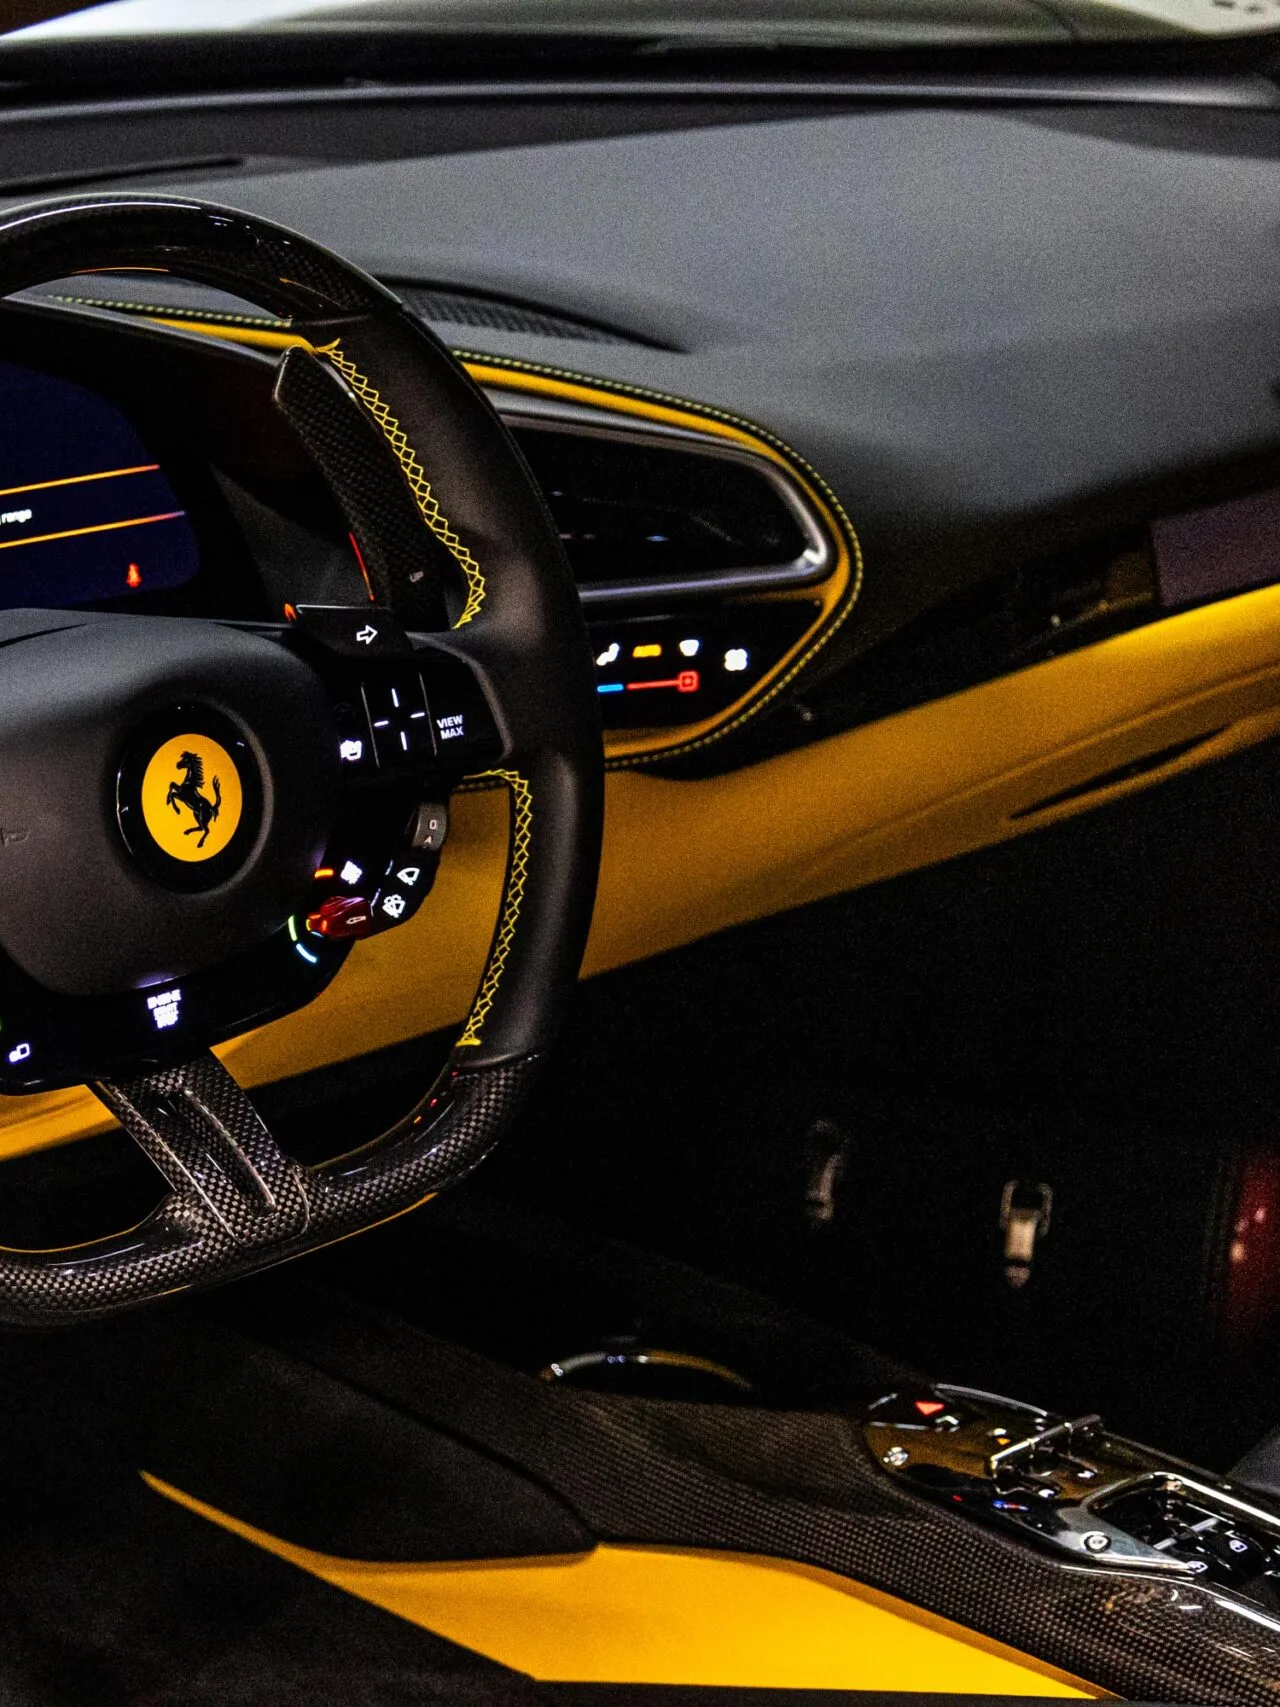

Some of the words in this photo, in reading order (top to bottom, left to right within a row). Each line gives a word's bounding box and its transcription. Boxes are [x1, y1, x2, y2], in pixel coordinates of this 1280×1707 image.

[1, 508, 33, 524] range
[436, 714, 463, 729] VIEW
[440, 726, 464, 740] MAX
